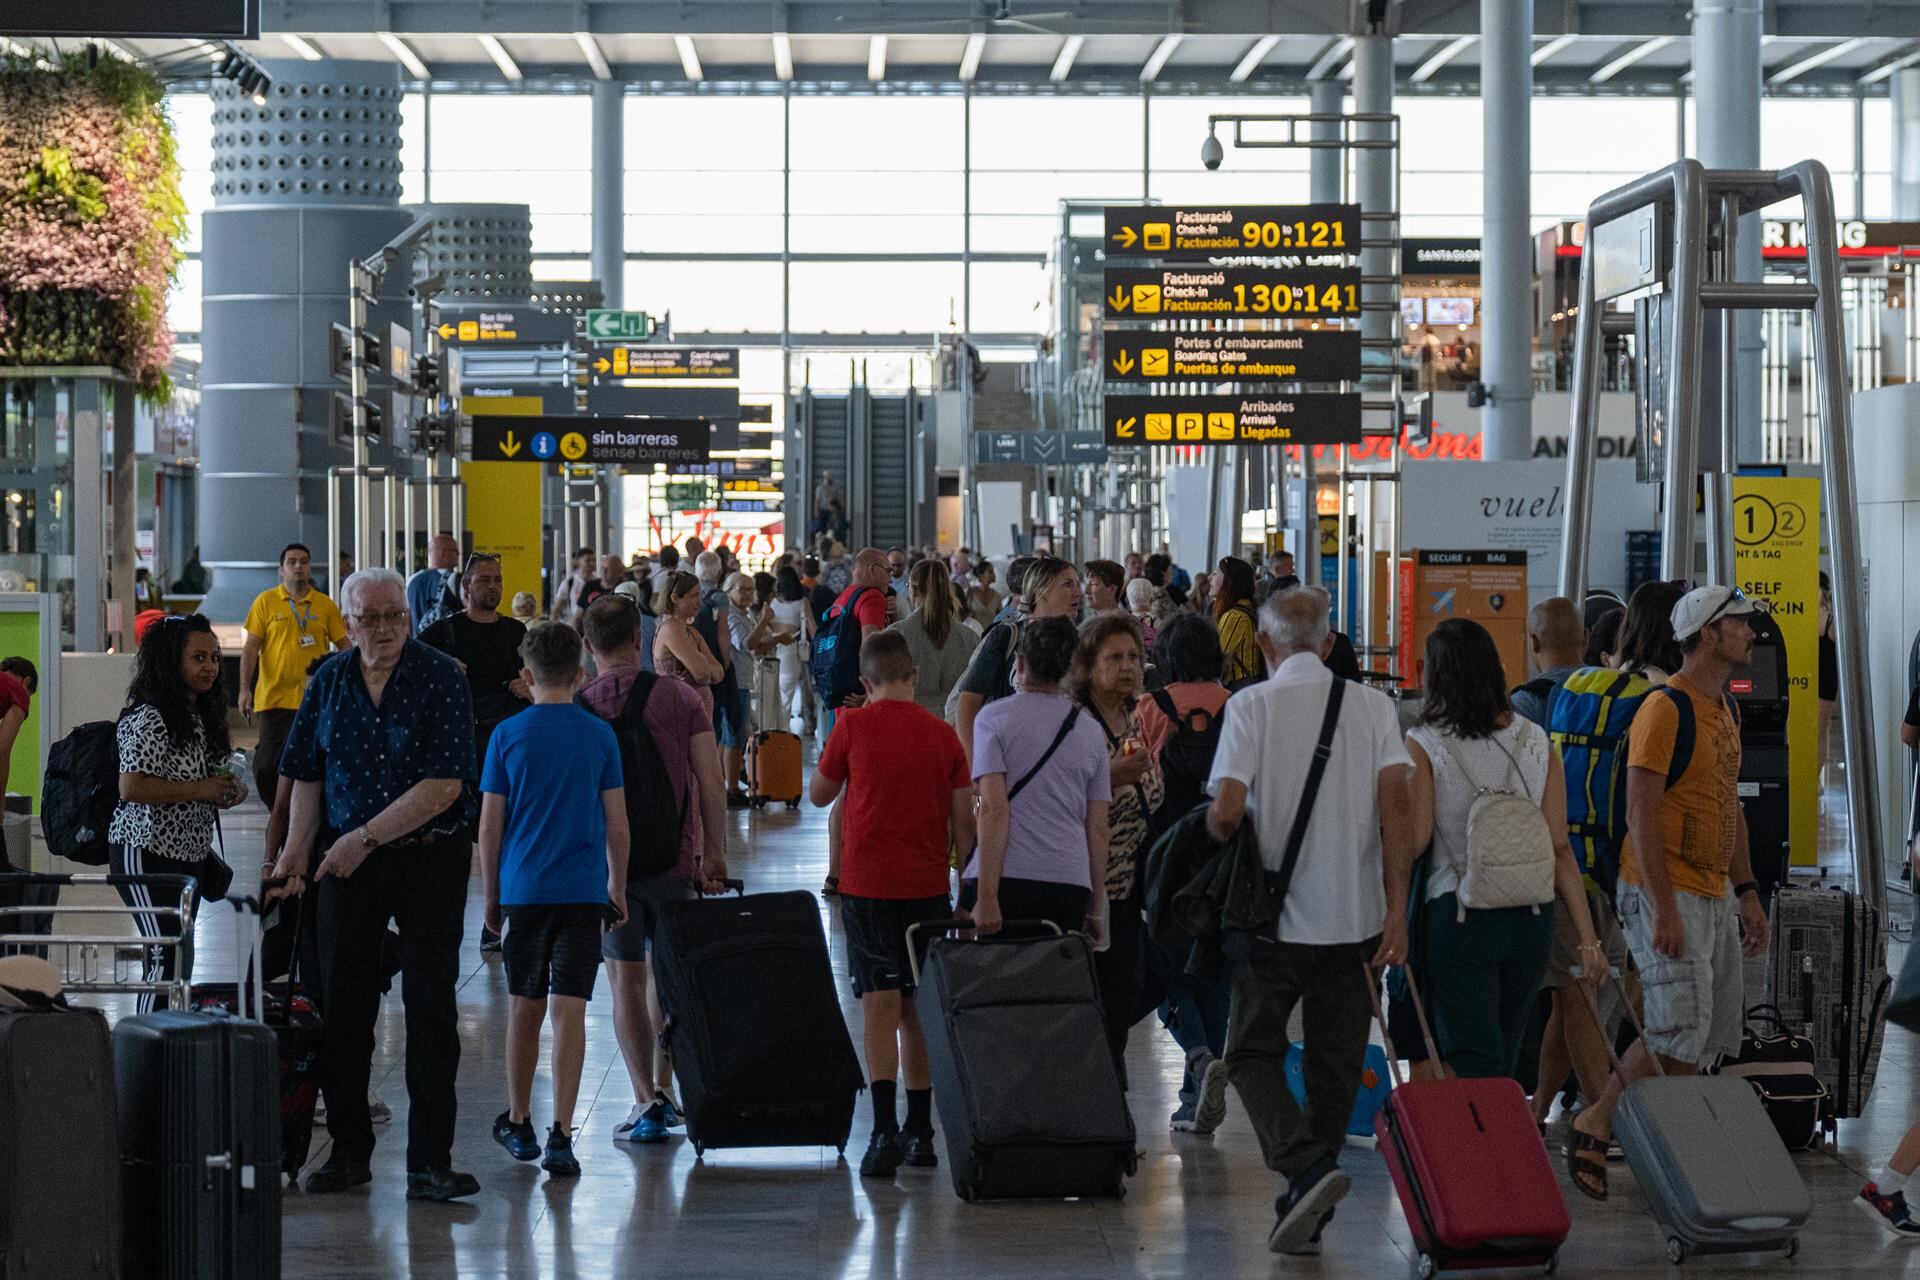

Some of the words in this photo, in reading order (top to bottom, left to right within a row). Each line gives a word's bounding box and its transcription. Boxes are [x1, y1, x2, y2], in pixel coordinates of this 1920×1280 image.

[1176, 211, 1232, 223] Facturació
[1176, 224, 1218, 236] Check-in
[1242, 221, 1280, 248] 90
[1294, 221, 1345, 248] 121
[1789, 221, 1867, 249] KG
[1176, 236, 1239, 249] Facturación
[1417, 249, 1480, 262] SANTAGLOR
[1163, 272, 1225, 285] Facturació
[1163, 286, 1208, 298] Check-in
[1233, 283, 1292, 313] 130
[1303, 284, 1359, 313] 141
[1163, 299, 1232, 312] Facturación
[1175, 337, 1211, 349] Portes
[1175, 350, 1217, 363] Boarding
[1219, 350, 1247, 362] Gates
[1175, 363, 1218, 375] Puertas
[1221, 363, 1236, 375] de
[1239, 363, 1296, 377] embarque
[1240, 400, 1295, 413] Arribades
[1240, 413, 1276, 425] Arrivals
[592, 430, 615, 446] sin
[617, 431, 678, 447] barreras
[1240, 426, 1291, 440] Llegadas
[592, 446, 636, 460] sense
[639, 444, 699, 460] barreres
[1480, 486, 1565, 518] vuel
[1744, 506, 1754, 534] 1
[1781, 511, 1794, 531] 2
[1428, 553, 1463, 562] SECURE
[1487, 553, 1506, 562] BAG
[1736, 550, 1749, 558] NT
[1752, 550, 1760, 558] &
[1762, 550, 1781, 558] TAG
[1744, 582, 1782, 595] SELF
[1769, 602, 1804, 615] K-IN
[1789, 676, 1809, 690] ng
